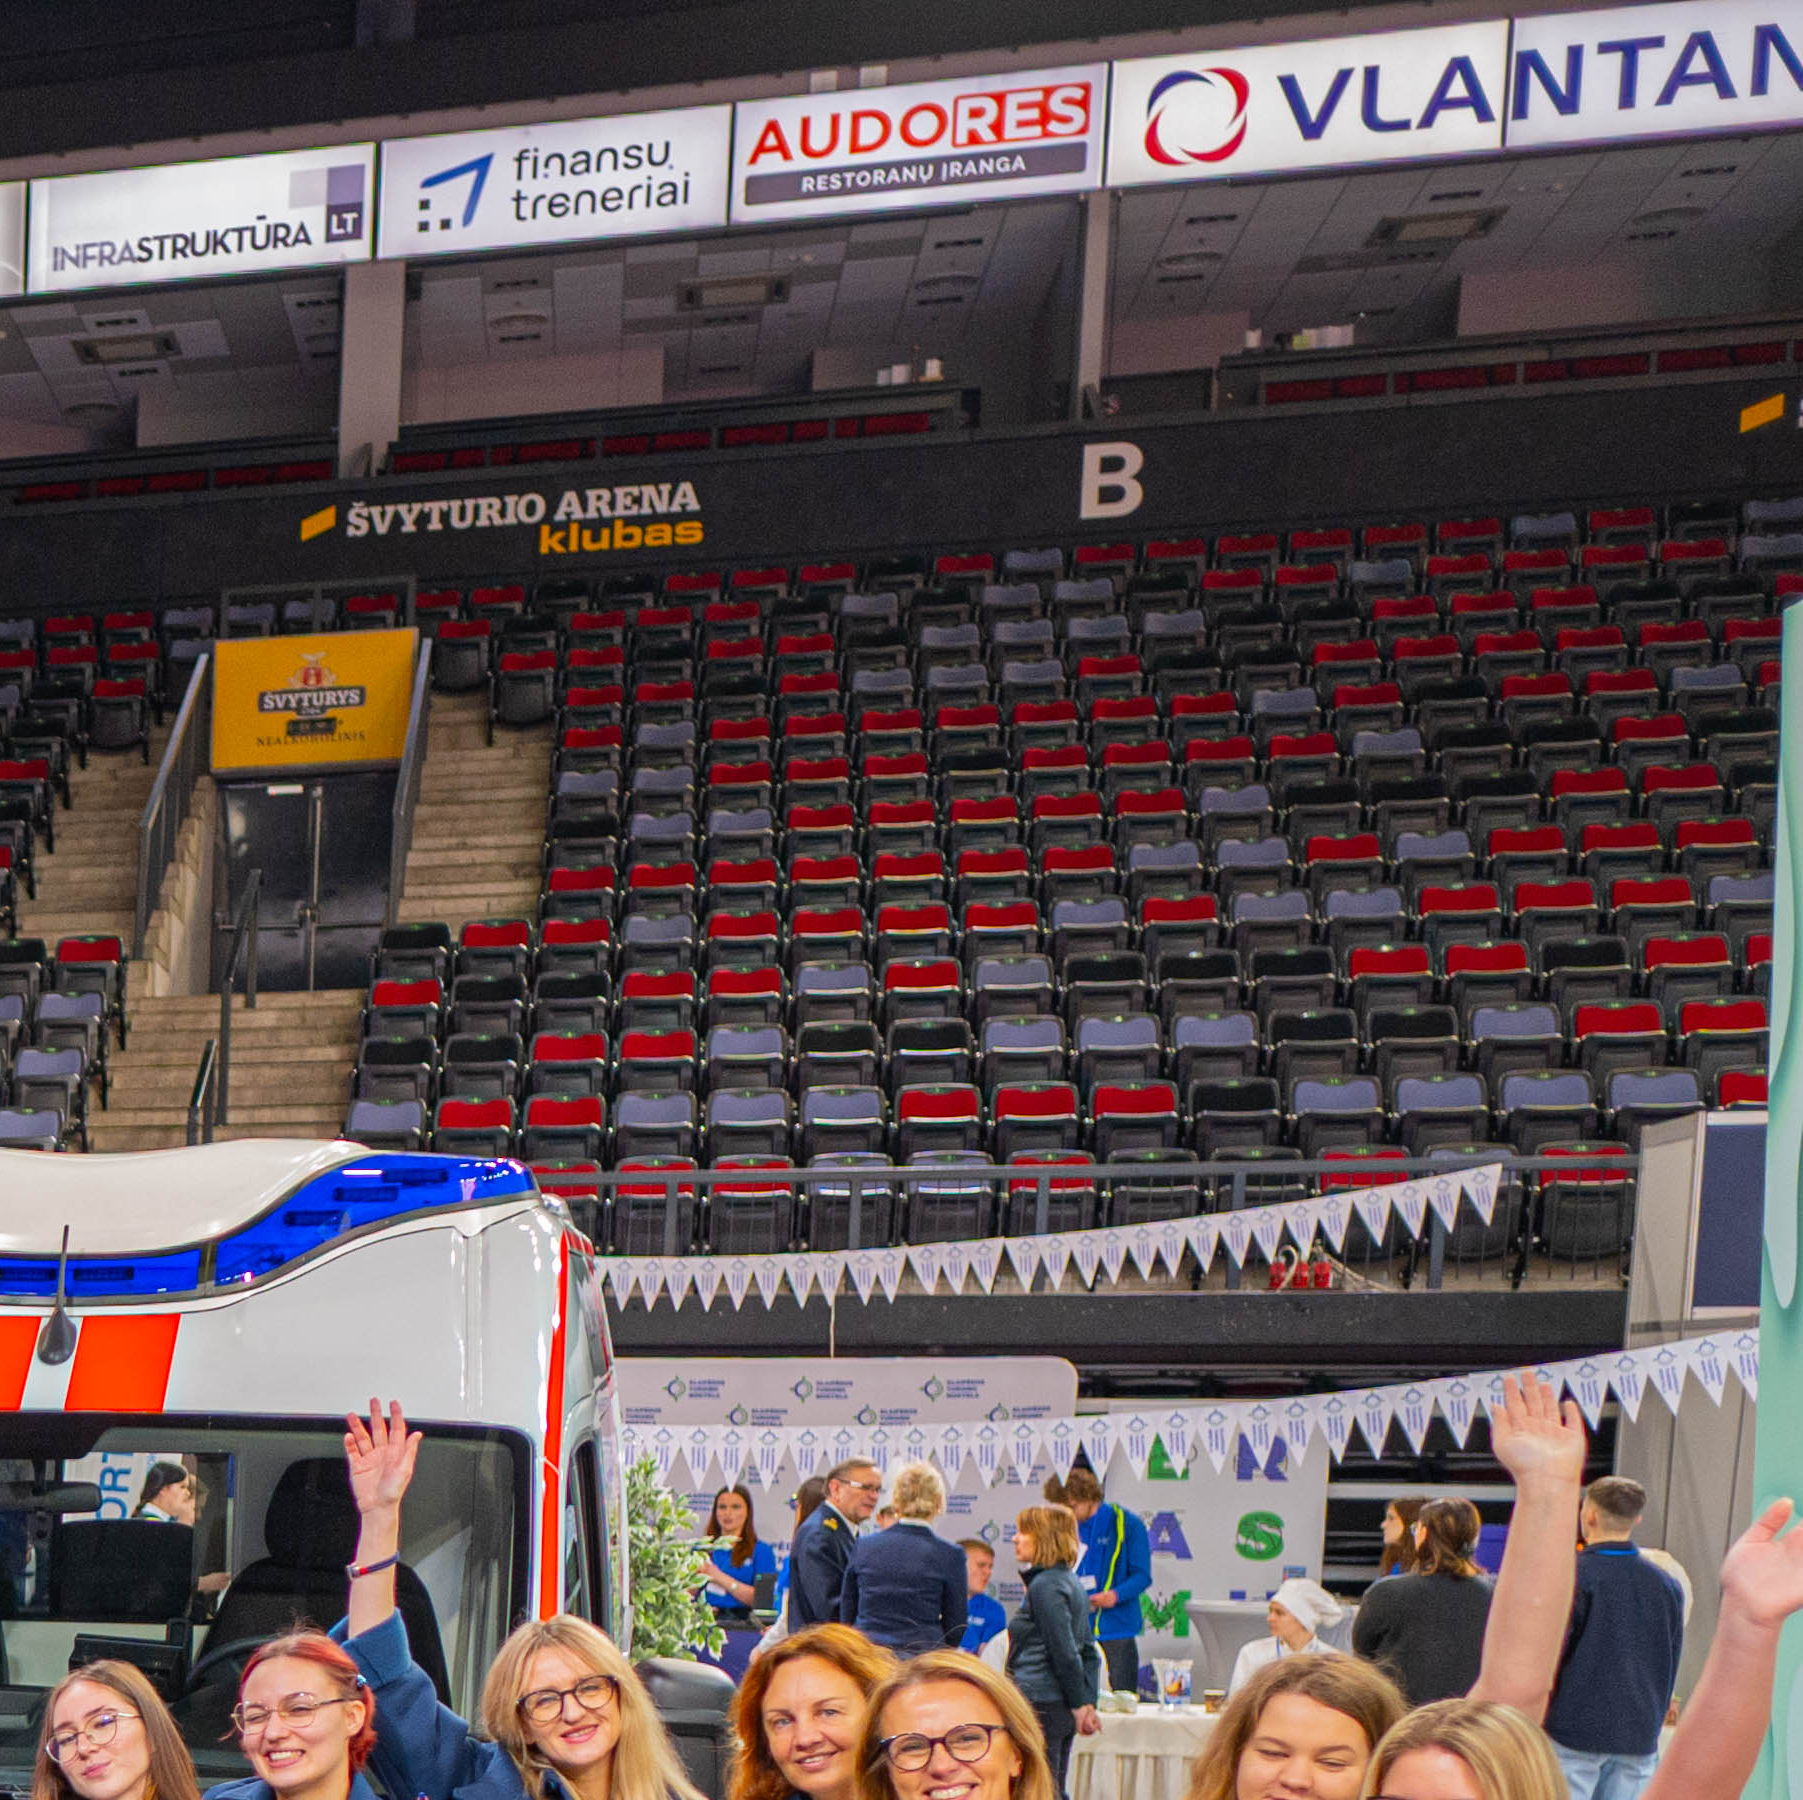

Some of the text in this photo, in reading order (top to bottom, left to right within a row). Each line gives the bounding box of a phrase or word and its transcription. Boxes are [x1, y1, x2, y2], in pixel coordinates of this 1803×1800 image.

[748, 84, 1090, 166] AUDORES
[513, 138, 676, 182] finansų
[801, 155, 1027, 193] RESTORANŲ ĮRANGA
[511, 172, 692, 222] treneriai
[52, 211, 360, 273] INFRASTRUKTŪRA LT
[1079, 441, 1145, 520] B
[346, 481, 701, 538] ŠVYTURIO ARENA
[538, 519, 705, 556] klubas
[262, 688, 361, 709] ŠVYTURYS
[1234, 1510, 1285, 1561] S
